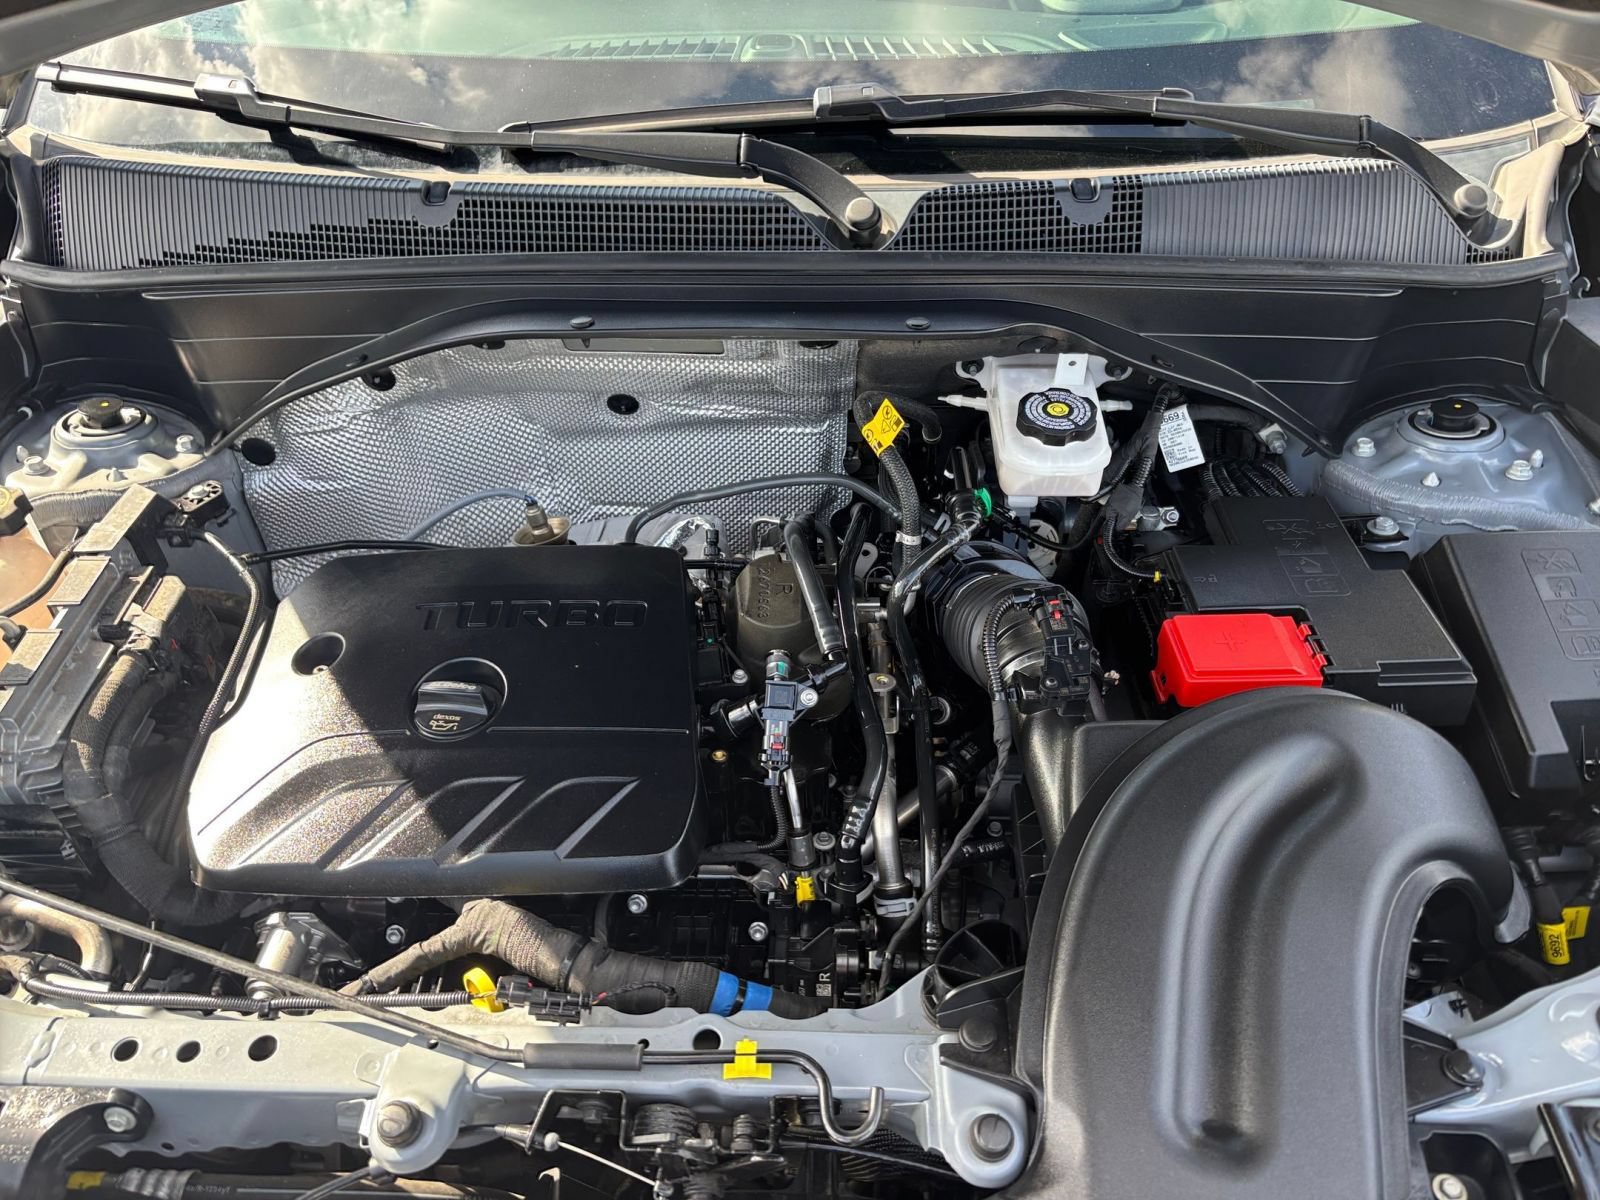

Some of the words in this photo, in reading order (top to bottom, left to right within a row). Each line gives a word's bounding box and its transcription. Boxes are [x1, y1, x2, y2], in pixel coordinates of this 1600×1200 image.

[775, 582, 794, 596] R
[416, 600, 648, 630] TURBO
[433, 713, 462, 721] dexos
[1549, 934, 1563, 957] 9692
[819, 972, 831, 981] R
